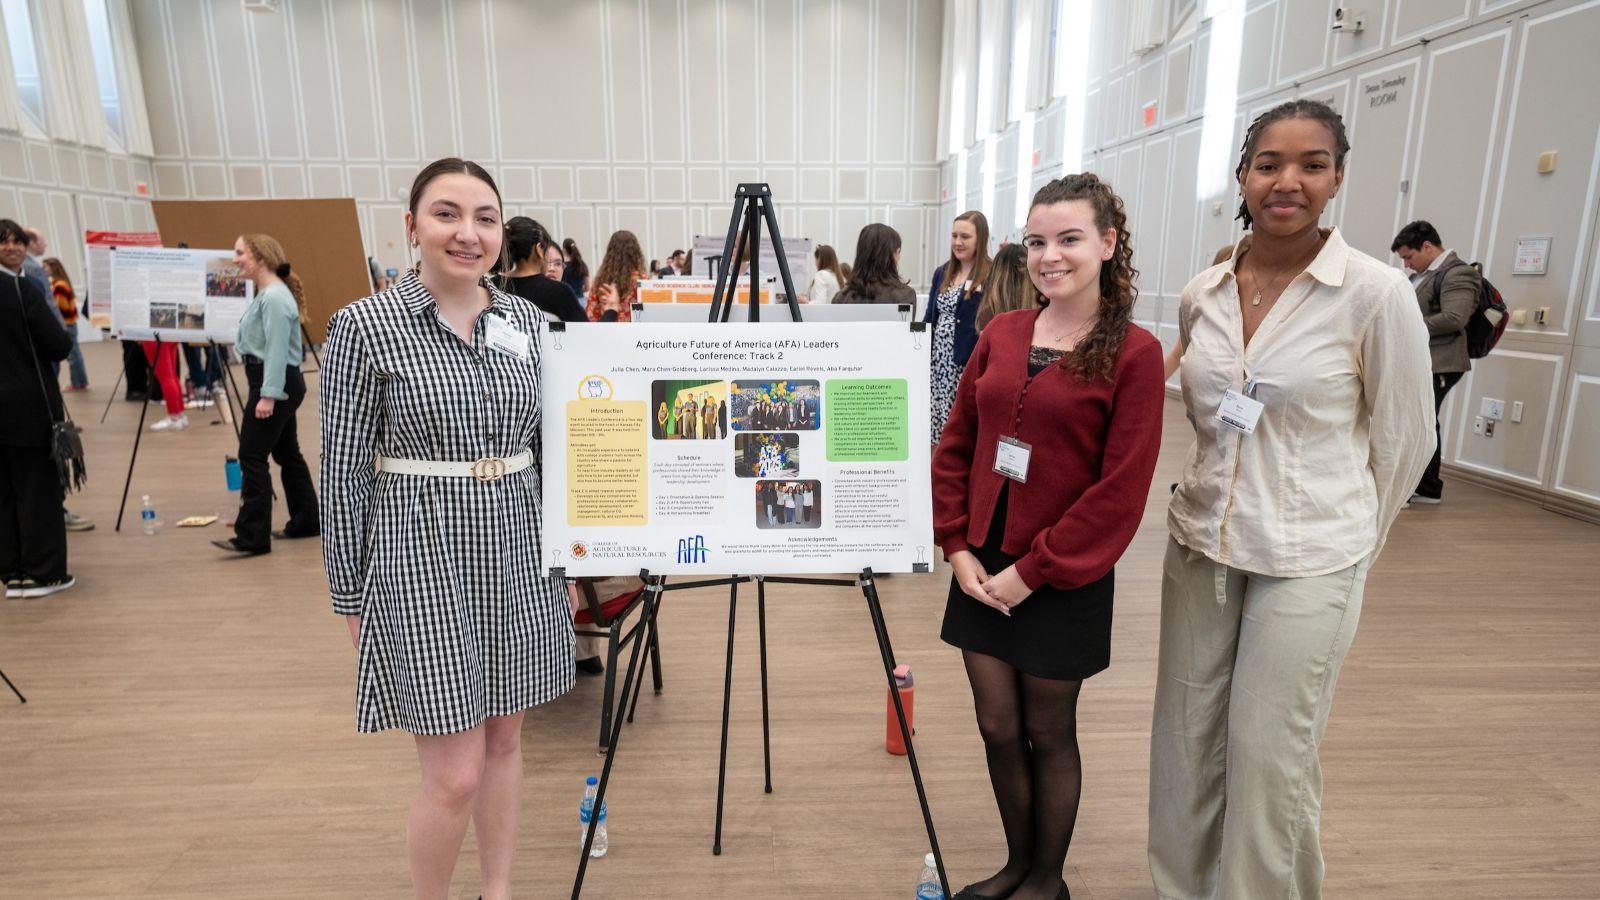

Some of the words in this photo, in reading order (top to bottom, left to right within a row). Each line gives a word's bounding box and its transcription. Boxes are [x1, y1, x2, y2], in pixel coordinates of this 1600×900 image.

[636, 340, 687, 350] Agriculture
[690, 340, 720, 348] Future
[722, 340, 731, 348] of
[735, 340, 772, 348] America
[774, 340, 800, 349] (AFA)
[804, 340, 839, 348] Leaders
[692, 352, 747, 360] Conference:
[677, 535, 706, 563] AFA
